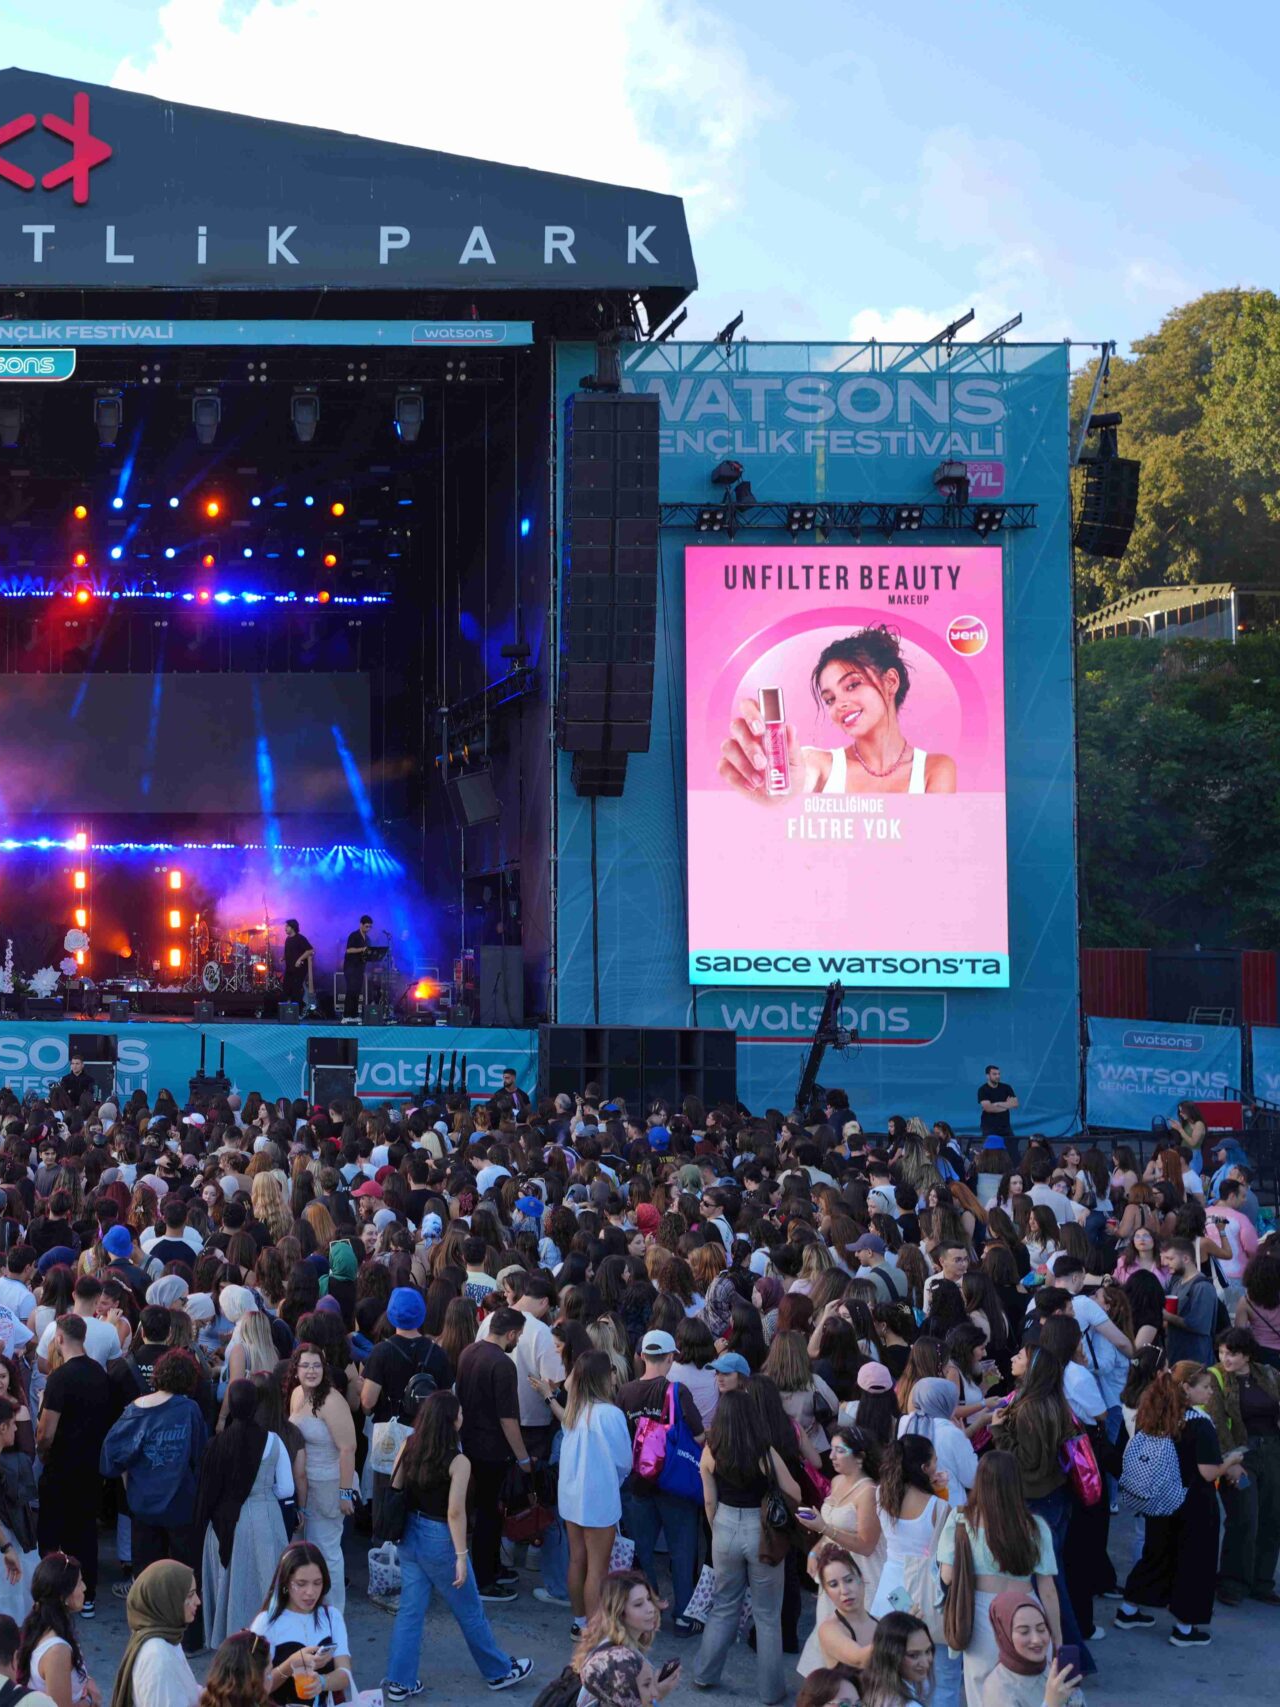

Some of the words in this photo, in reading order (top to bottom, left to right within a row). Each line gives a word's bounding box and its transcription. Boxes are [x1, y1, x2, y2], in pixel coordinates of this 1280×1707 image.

[378, 225, 659, 265] PARK
[65, 322, 174, 339] FESTİVALİ
[424, 327, 494, 338] watsons
[659, 422, 798, 460] ENÇLİK
[803, 424, 1004, 456] FESTİVALİ
[967, 471, 1001, 487] YIL
[723, 565, 850, 590] UNFILTER
[860, 565, 962, 590] BEAUTY
[888, 594, 930, 605] MAKEUP
[787, 814, 854, 839] FİLTRE
[863, 818, 902, 839] YOK
[1133, 1034, 1193, 1048] watsons
[1097, 1063, 1230, 1089] WATSONS
